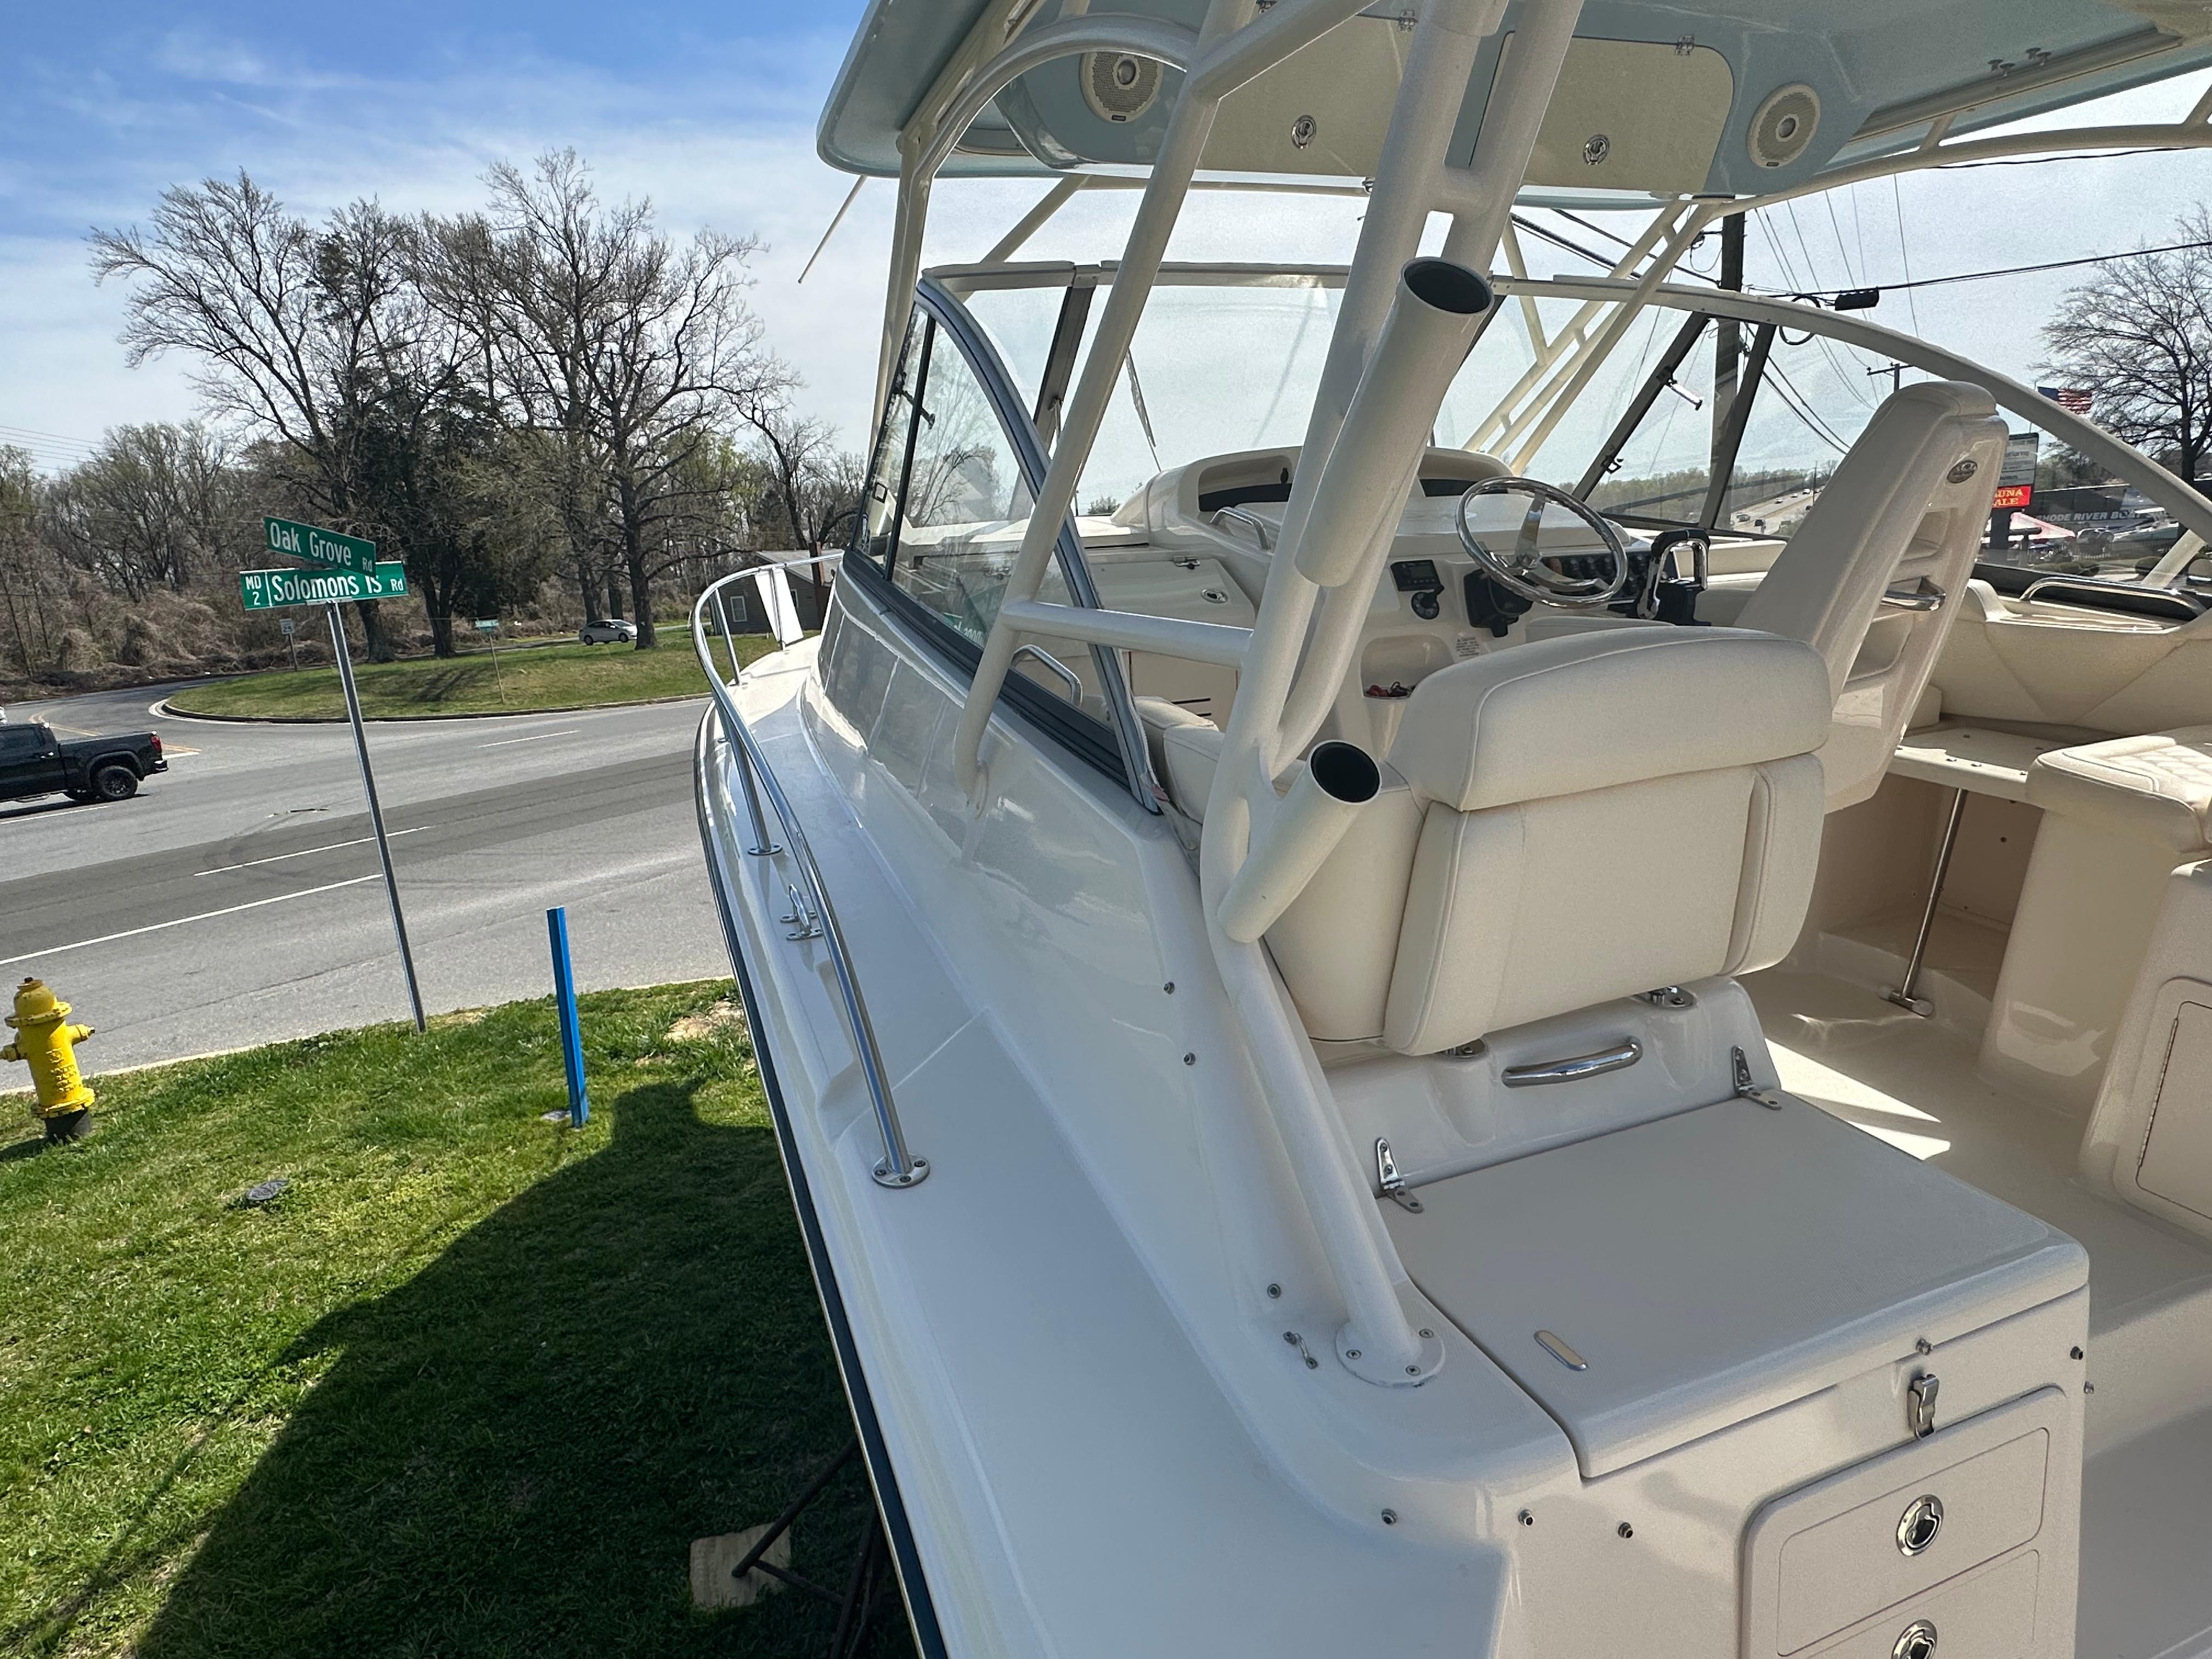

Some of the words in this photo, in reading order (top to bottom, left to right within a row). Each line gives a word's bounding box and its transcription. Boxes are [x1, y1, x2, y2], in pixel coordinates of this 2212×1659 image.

[2074, 511, 2108, 521] RIVER
[270, 522, 301, 553] Oak
[309, 531, 351, 566] Grove
[362, 556, 373, 572] Rd
[245, 575, 262, 590] MD
[272, 574, 359, 601] Solomons
[390, 578, 404, 591] Rd
[252, 591, 261, 606] 2
